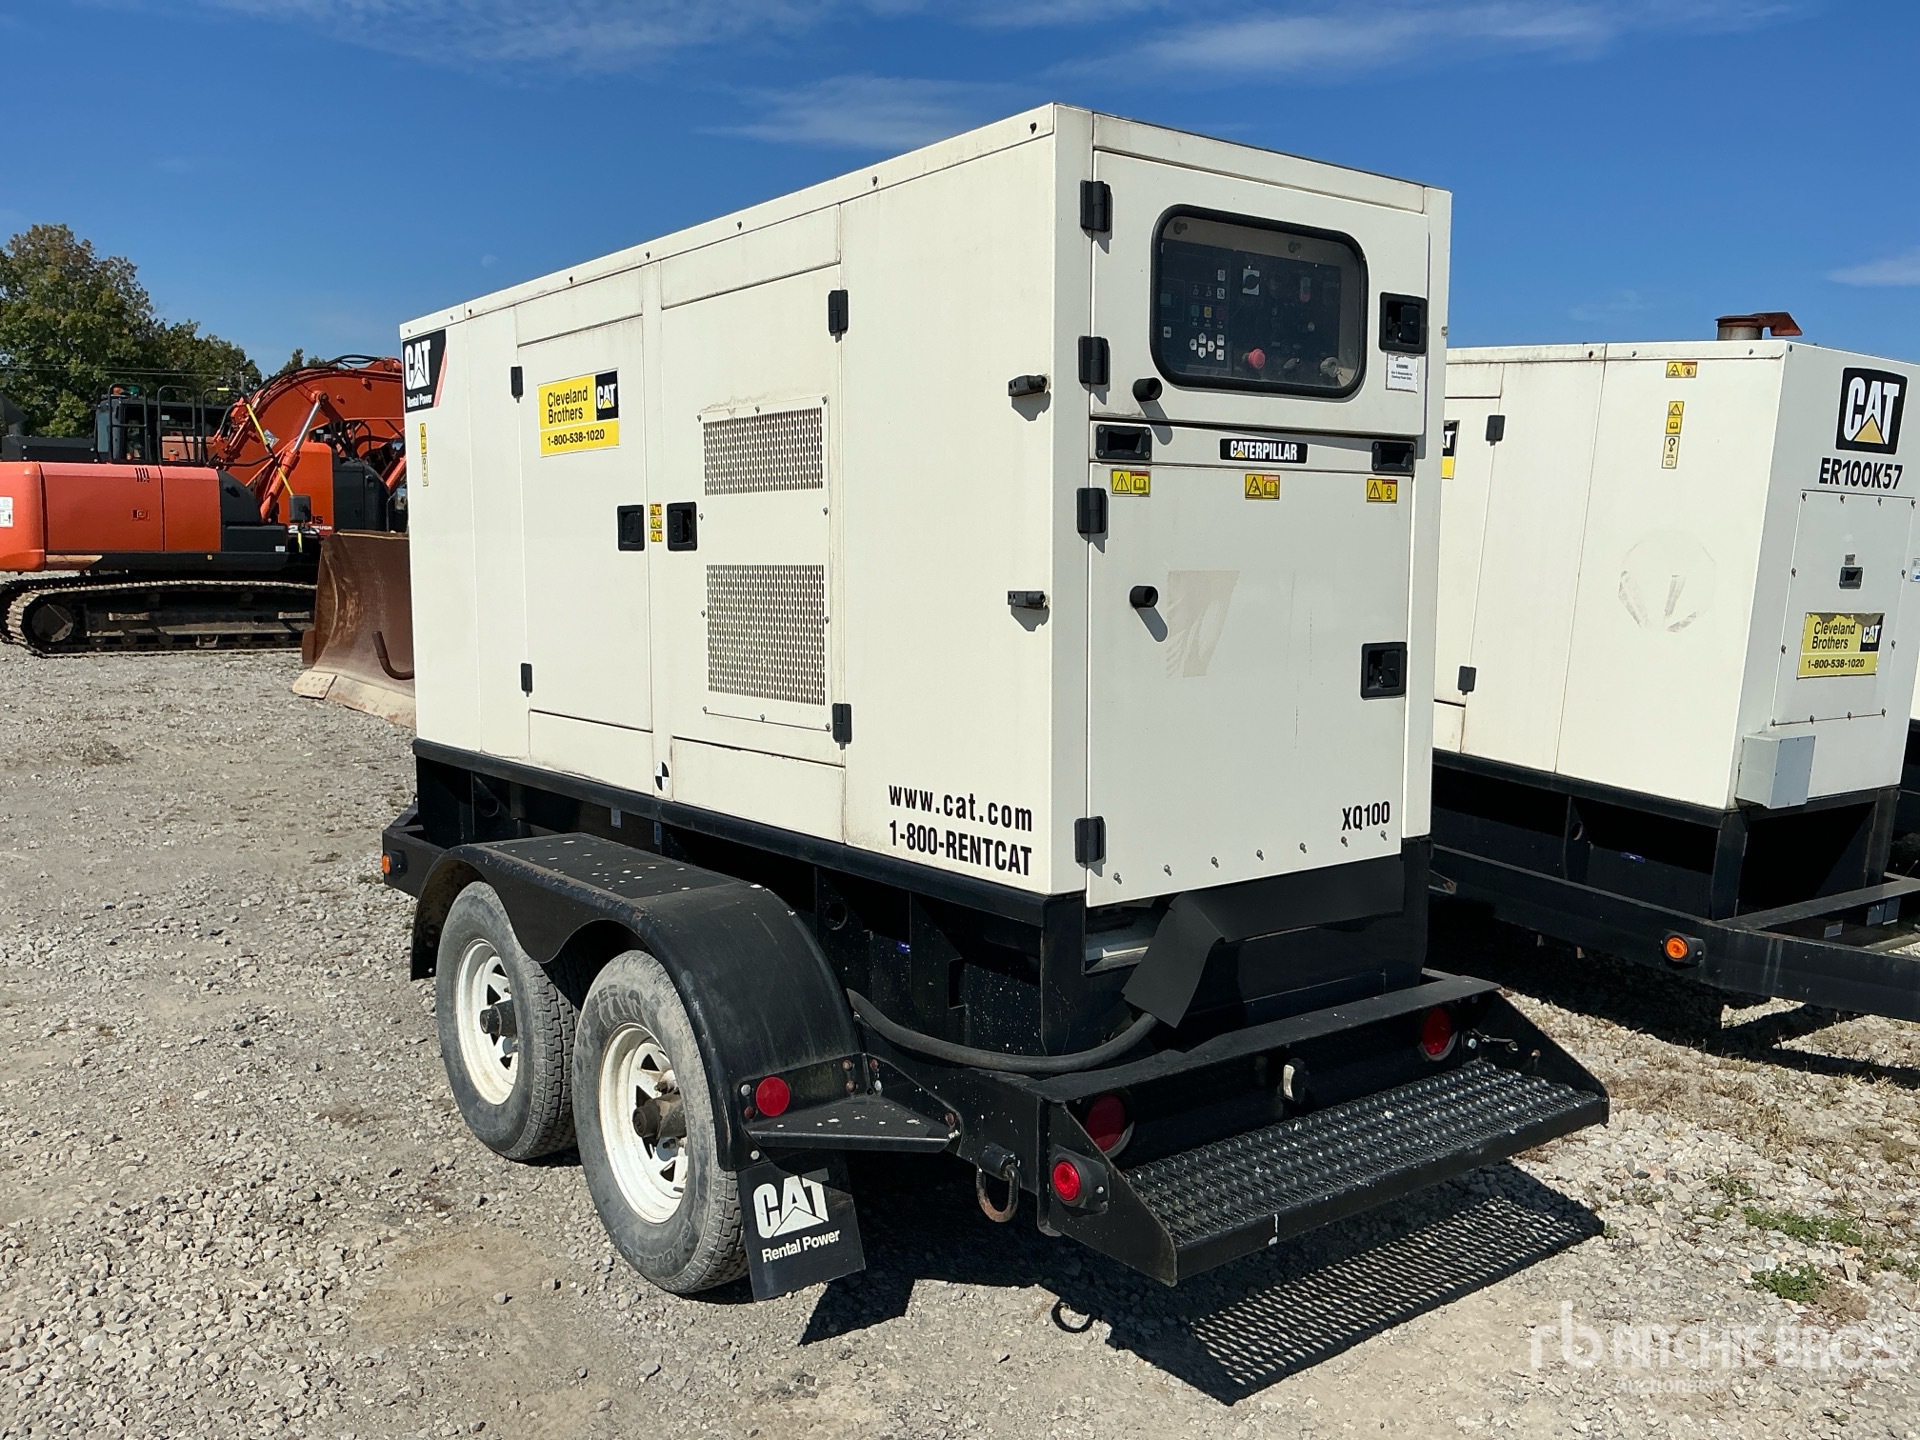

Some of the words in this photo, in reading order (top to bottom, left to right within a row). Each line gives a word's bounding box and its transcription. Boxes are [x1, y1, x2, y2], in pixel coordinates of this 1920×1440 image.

[405, 340, 431, 390] CAT
[548, 386, 588, 408] Cleveland
[597, 384, 616, 409] CAT
[549, 406, 583, 424] Brothers
[1844, 377, 1900, 445] CAT
[547, 429, 605, 446] 1-800-538-1020
[1230, 440, 1298, 461] CATERPILLAR
[1819, 457, 1904, 490] ER100K57
[1814, 621, 1856, 635] Cleveland
[1862, 625, 1881, 643] CAT
[1812, 636, 1849, 649] Brothers
[1807, 658, 1865, 669] 1-800-538-1020
[888, 785, 1032, 832] www.cat.com
[1341, 801, 1390, 831] XQ100
[889, 819, 1032, 876] 1-800-RENTCAT
[753, 1168, 829, 1239] CAT
[762, 1239, 801, 1263] Rental
[802, 1230, 841, 1251] Power
